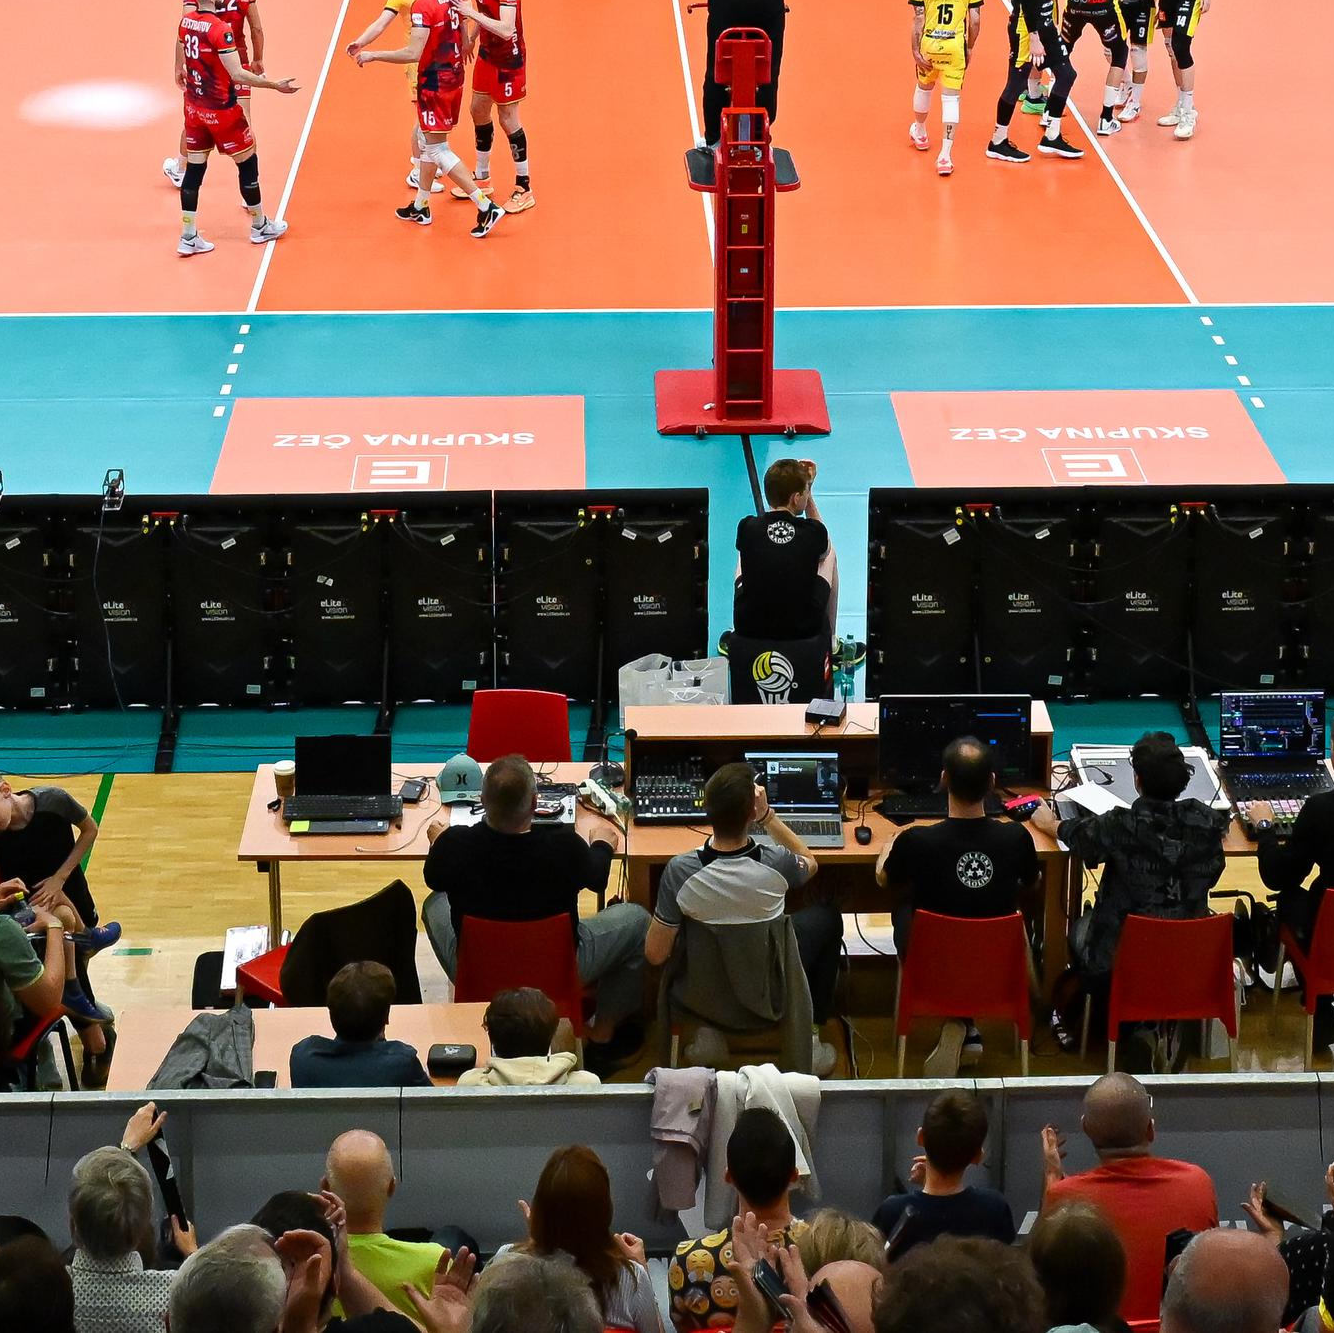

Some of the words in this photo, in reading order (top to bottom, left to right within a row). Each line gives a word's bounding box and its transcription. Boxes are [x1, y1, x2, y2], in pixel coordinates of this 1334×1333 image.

[936, 3, 954, 26] 15
[1177, 15, 1187, 27] 14
[184, 34, 200, 60] 33
[504, 81, 513, 97] 5
[421, 110, 436, 127] 15
[350, 432, 536, 447] SKUPINA
[948, 426, 1026, 444] ČEZ
[1038, 425, 1211, 440] SKUPINA
[272, 433, 344, 451] ČEZ
